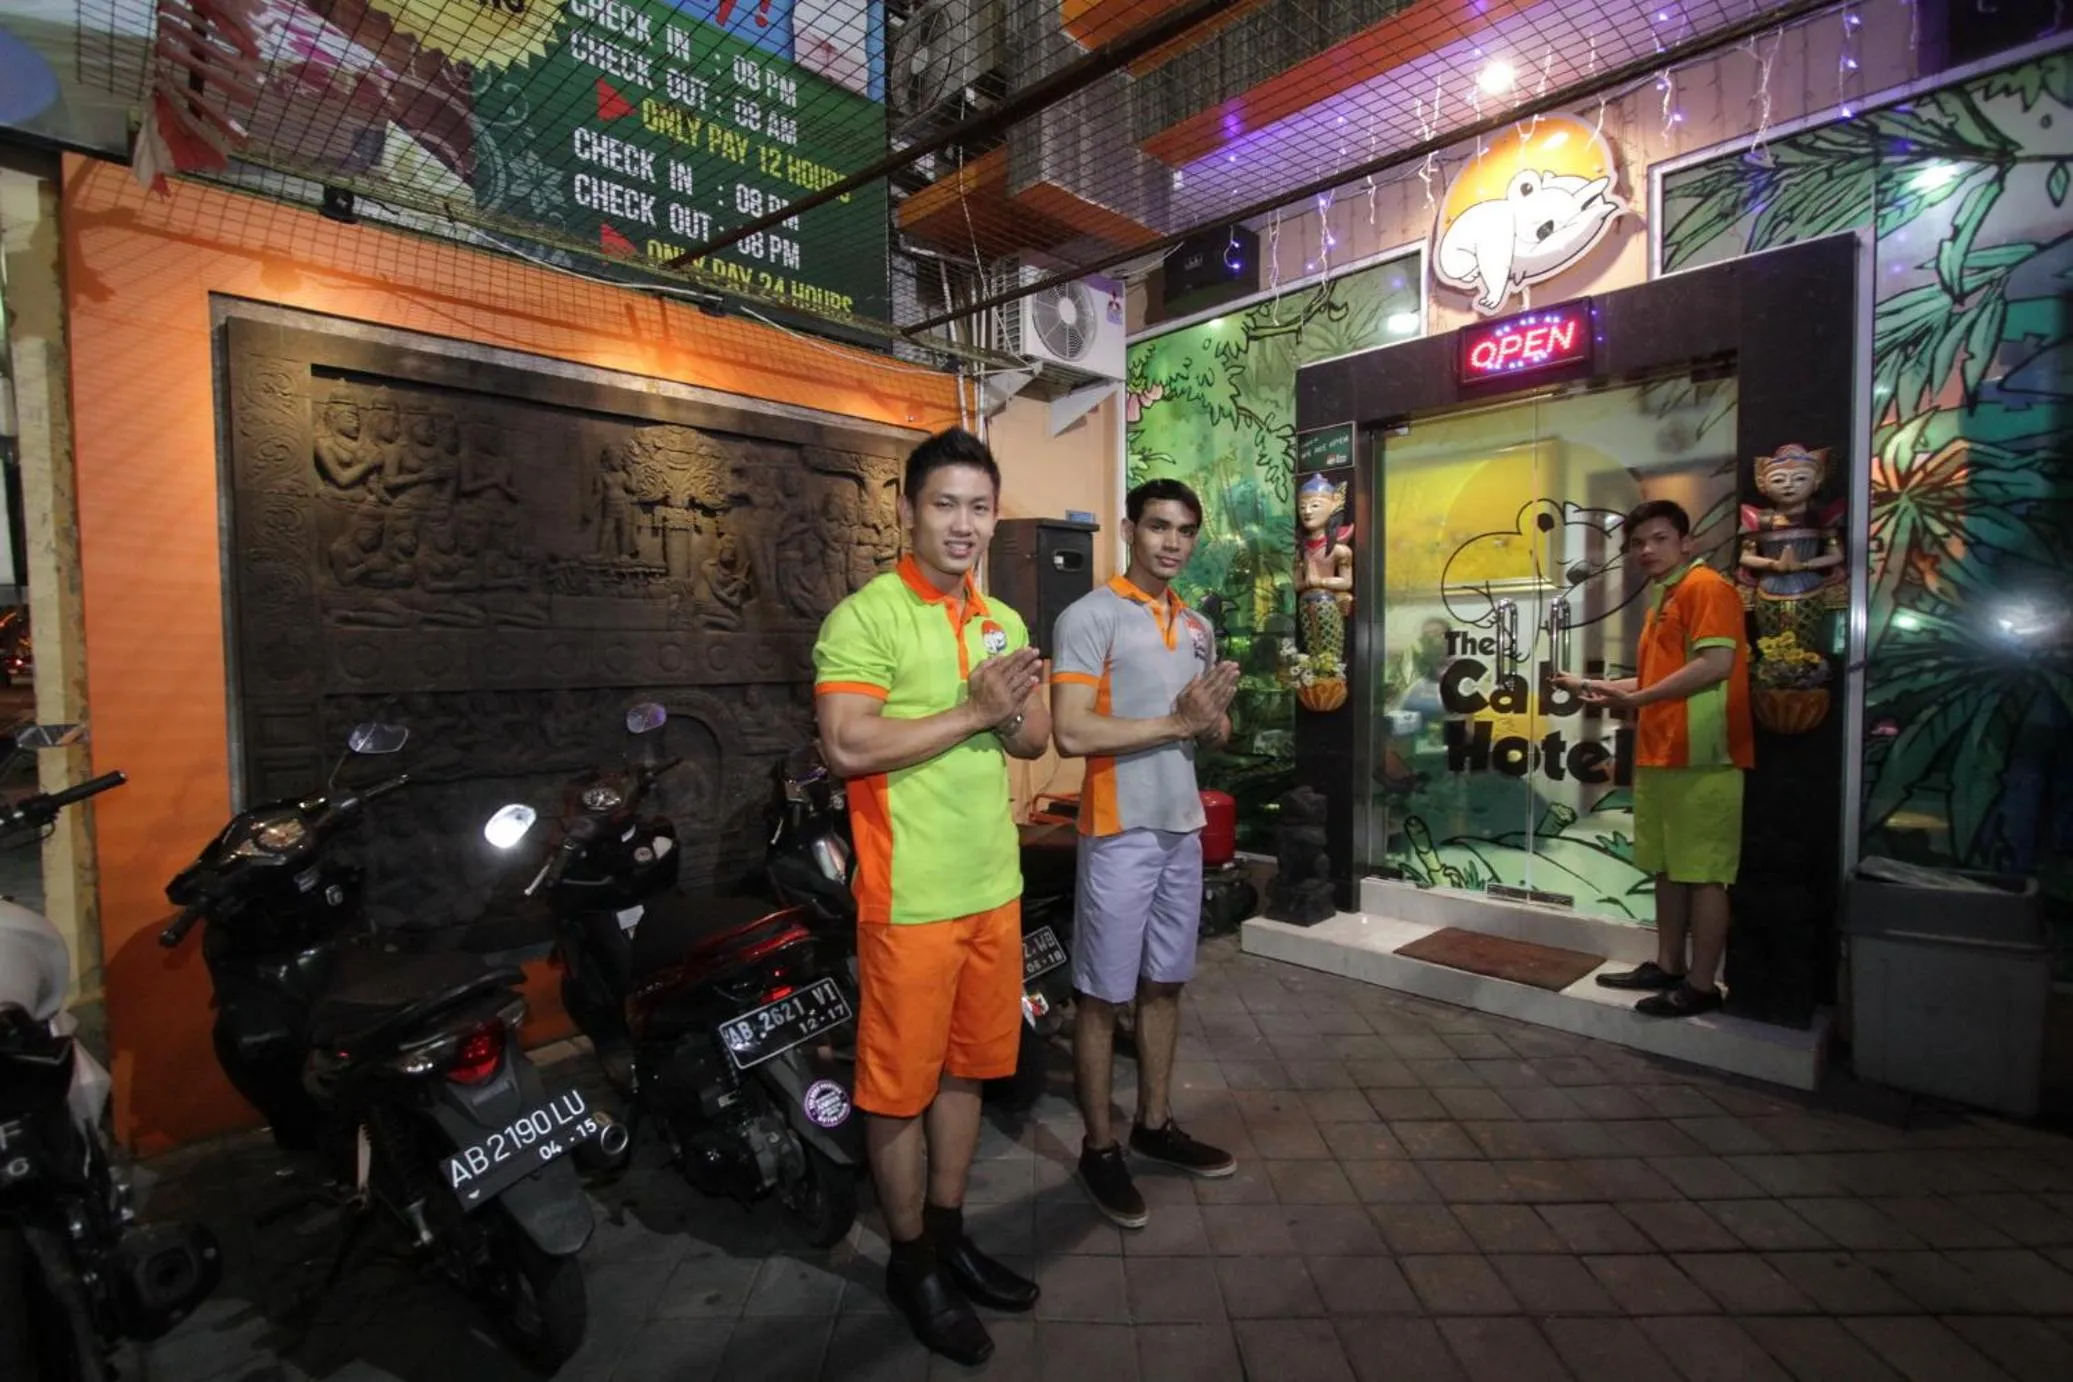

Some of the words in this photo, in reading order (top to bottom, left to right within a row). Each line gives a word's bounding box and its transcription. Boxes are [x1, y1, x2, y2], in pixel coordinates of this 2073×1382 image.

[570, 29, 653, 90] CHECK
[667, 68, 708, 111] OUT
[734, 96, 761, 132] 08
[767, 111, 797, 146] AM
[666, 24, 690, 63] IN
[733, 54, 761, 92] 08
[766, 69, 797, 108] PM
[574, 127, 656, 183] CHECK
[669, 159, 692, 196] IN
[736, 183, 762, 218] 08
[642, 98, 700, 147] ONLY
[708, 123, 748, 165] PAY
[759, 145, 782, 178] 12
[574, 174, 656, 225] CHECK
[669, 203, 711, 242] OUT
[769, 234, 799, 271] PM
[1471, 321, 1575, 368] OPEN
[1445, 631, 1496, 656] The
[1444, 720, 1634, 786] Hotel
[727, 1020, 755, 1046] AB
[758, 997, 806, 1032] 2621
[450, 1146, 489, 1189] AB
[486, 1110, 551, 1162] 2190
[550, 1089, 586, 1125] LU
